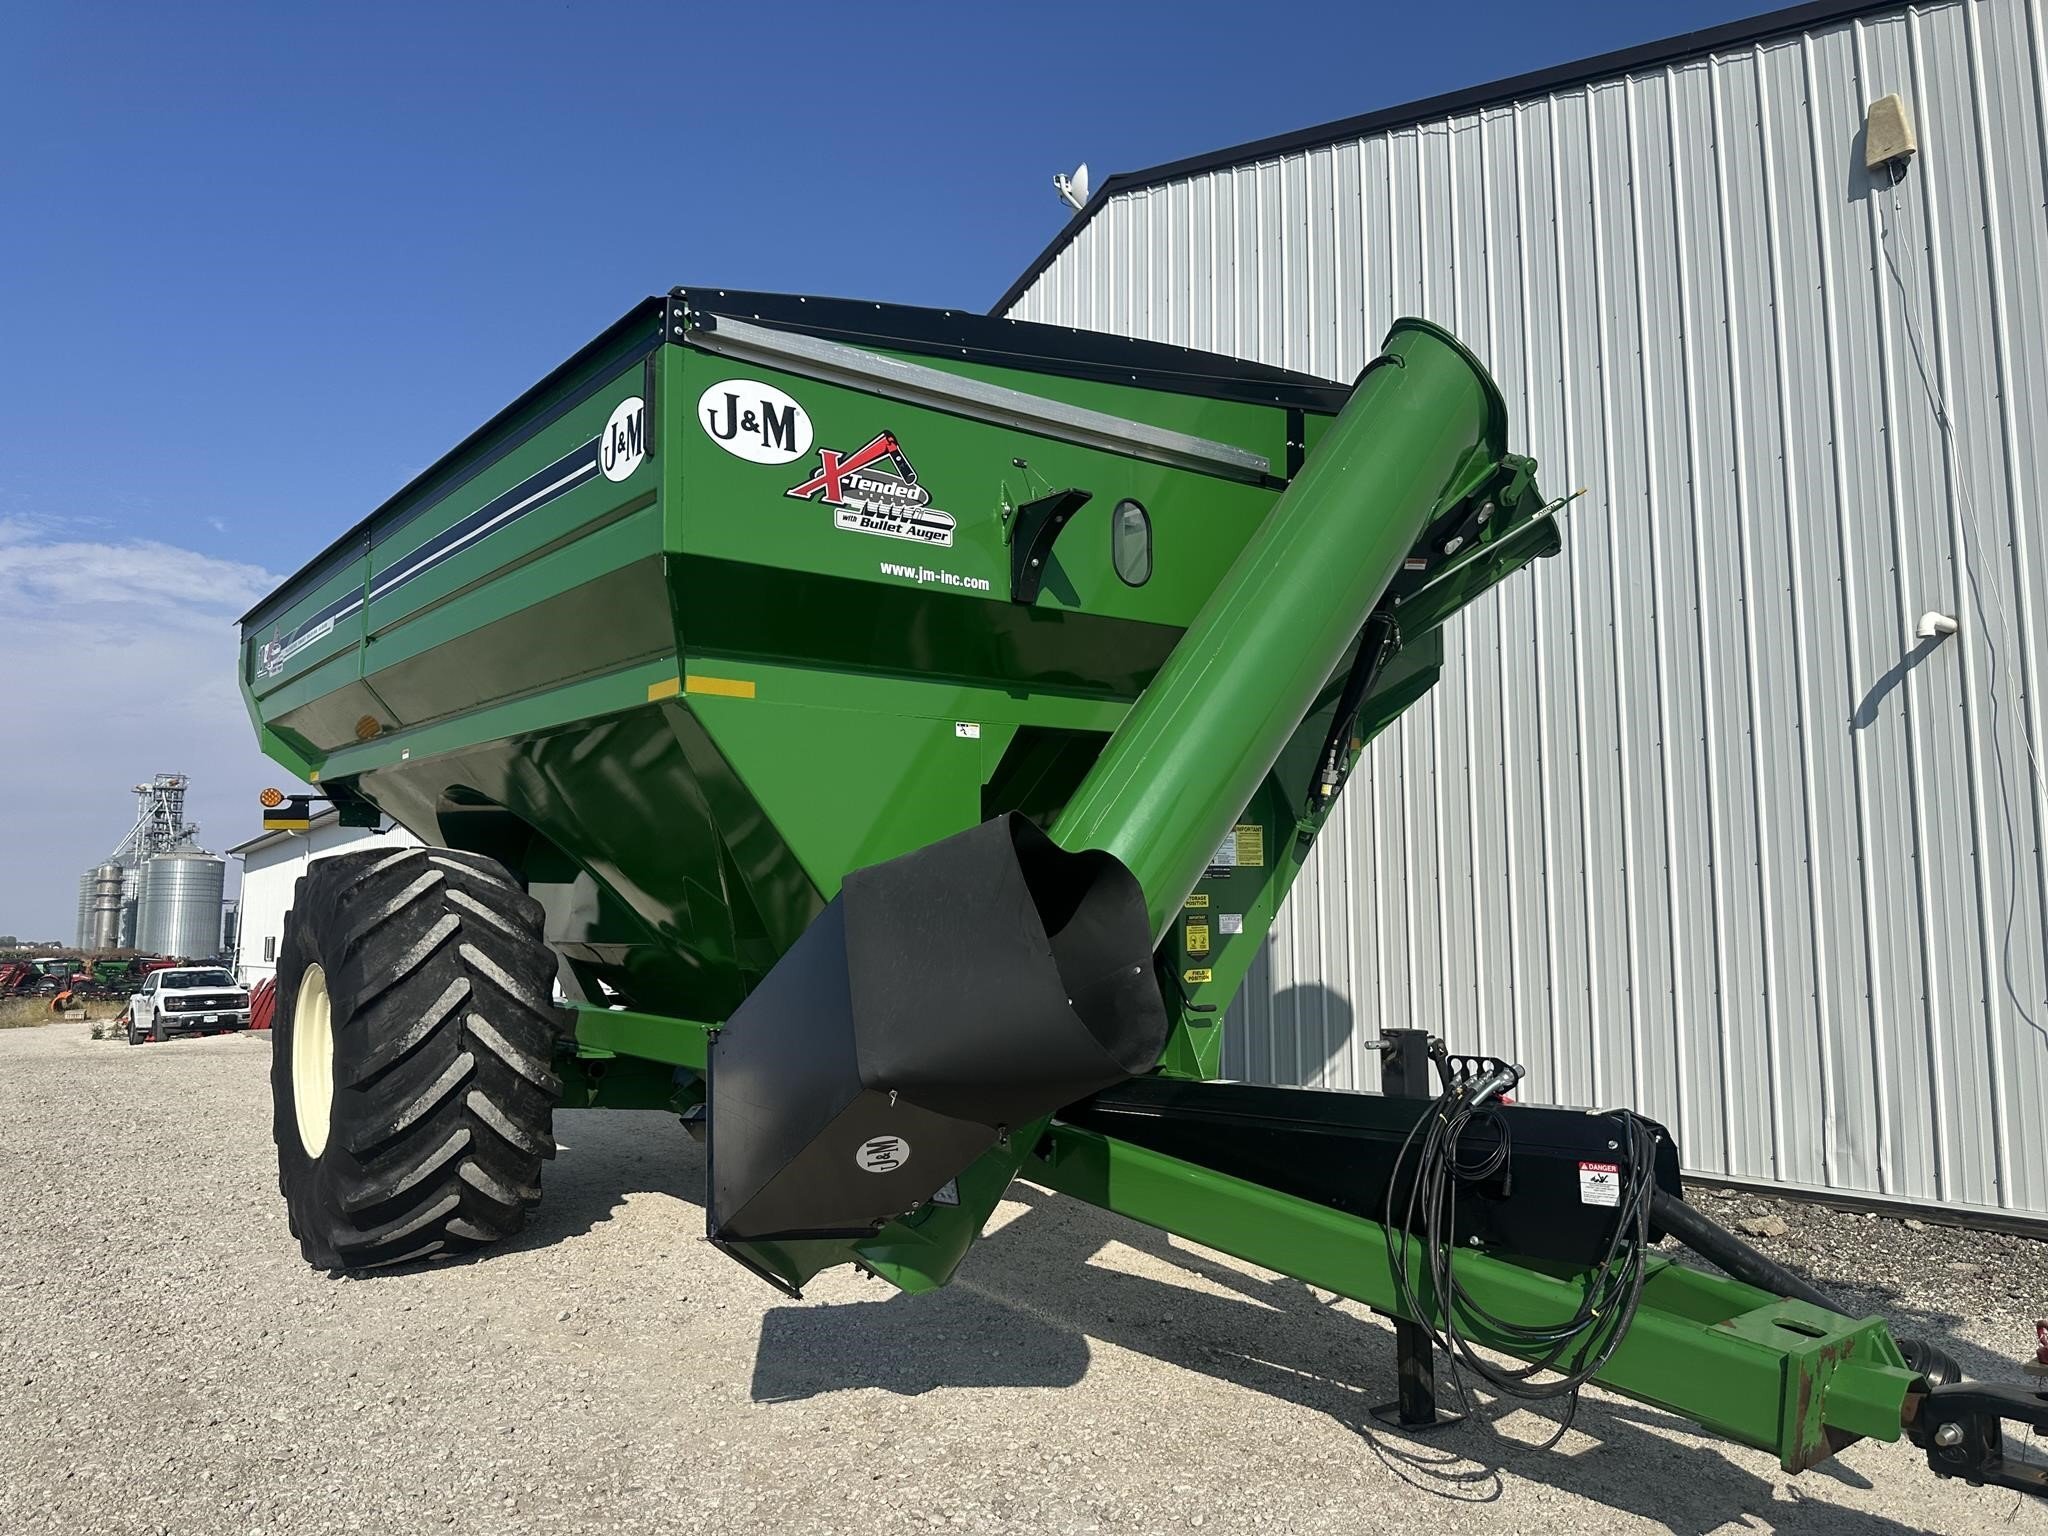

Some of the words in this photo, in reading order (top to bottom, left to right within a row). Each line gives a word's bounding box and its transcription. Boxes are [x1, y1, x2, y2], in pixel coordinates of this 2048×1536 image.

[707, 392, 798, 453] J&M
[604, 407, 645, 472] J&M
[842, 514, 858, 523] with
[860, 517, 903, 533] Bullet
[906, 526, 948, 541] Auger
[880, 562, 990, 591] www.jm-inc.com
[866, 1138, 899, 1171] J&M
[1588, 1163, 1617, 1172] DANGER
